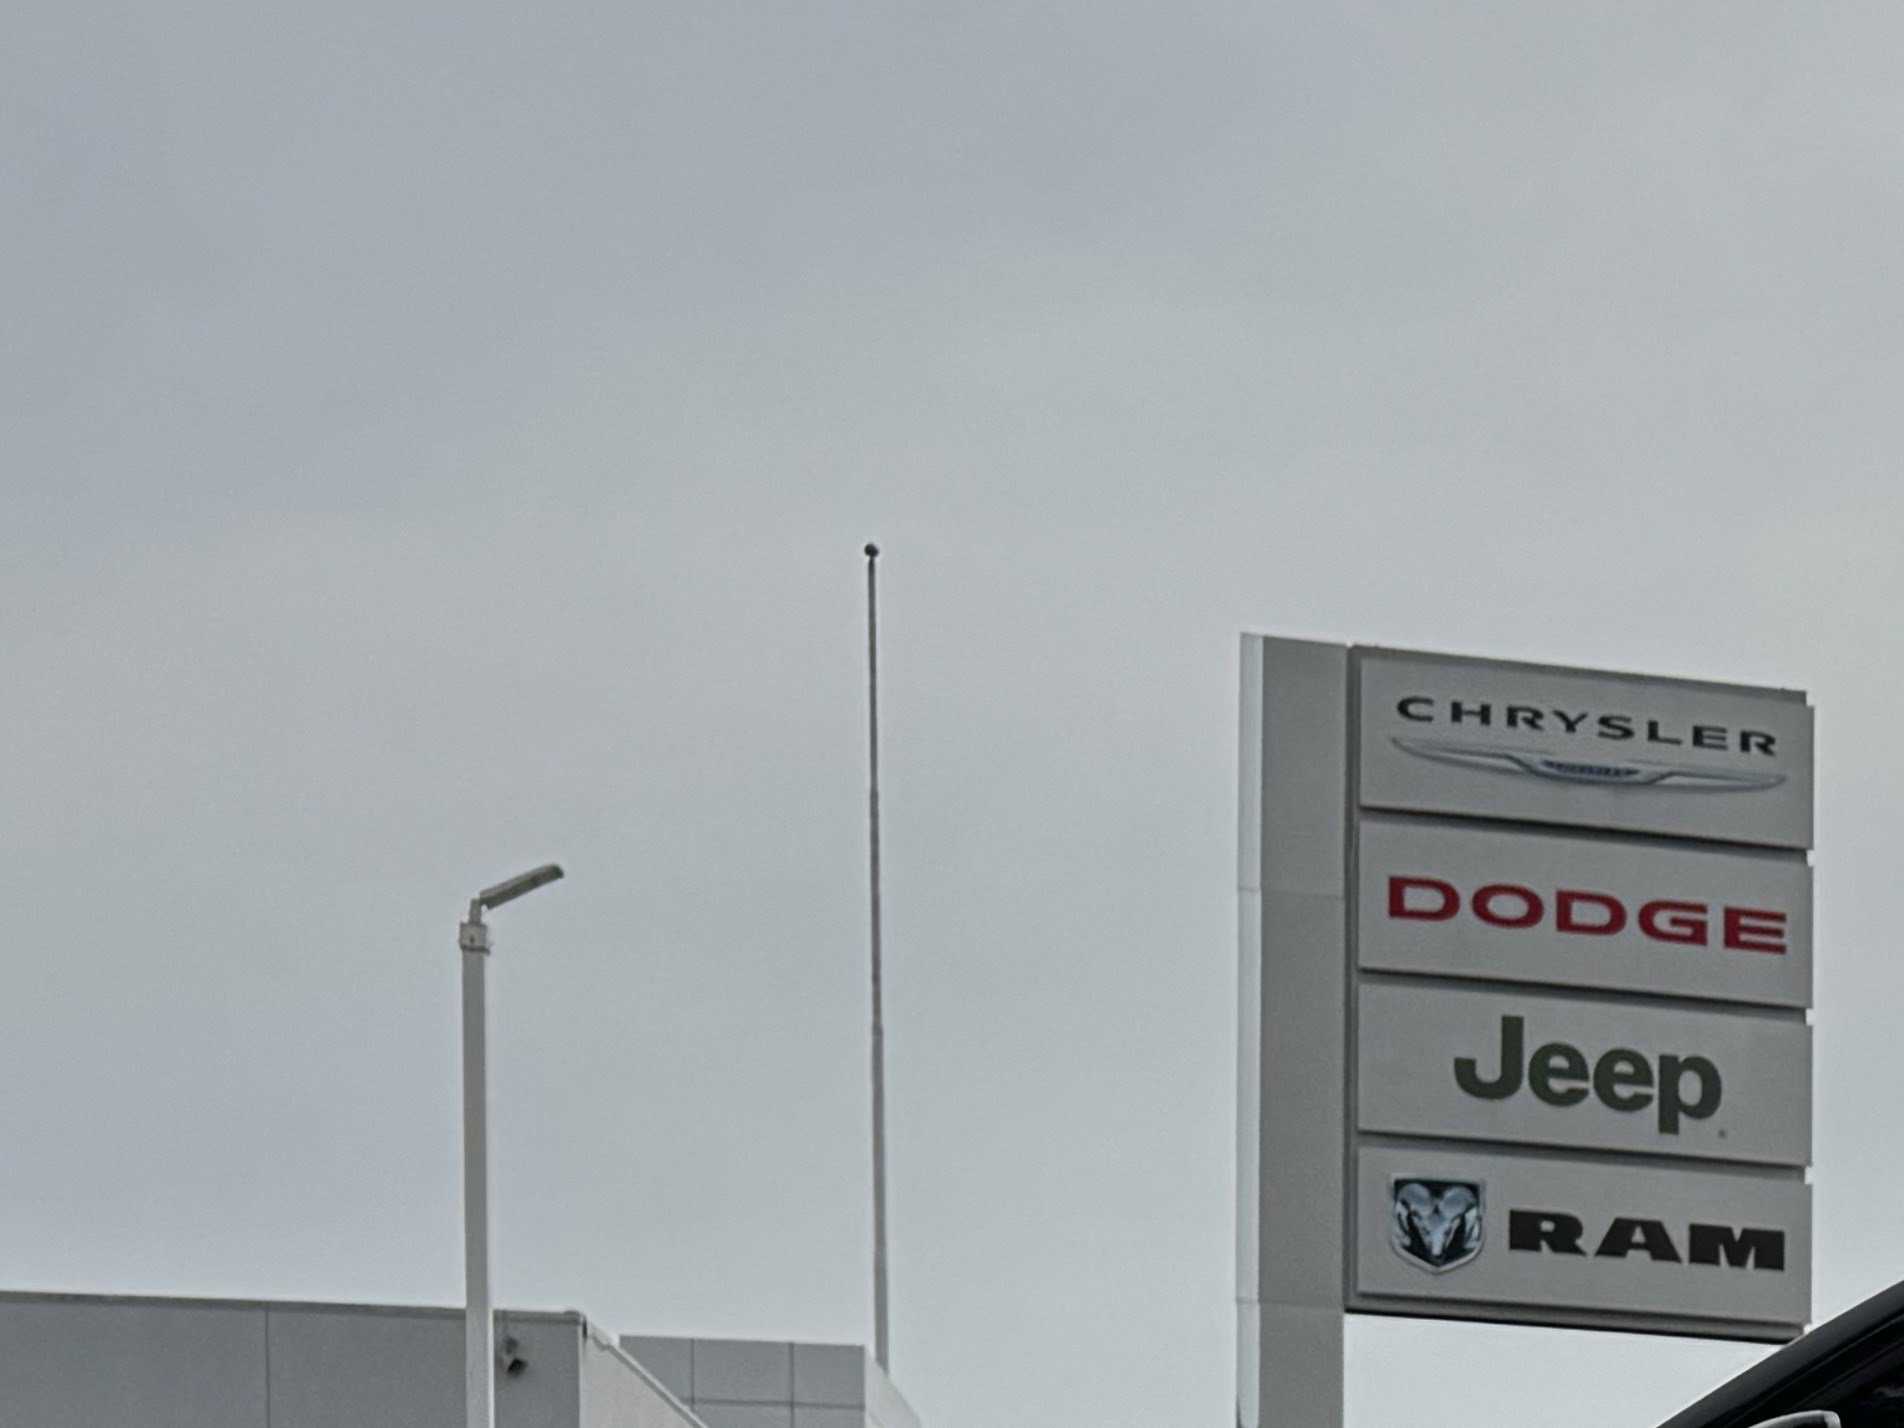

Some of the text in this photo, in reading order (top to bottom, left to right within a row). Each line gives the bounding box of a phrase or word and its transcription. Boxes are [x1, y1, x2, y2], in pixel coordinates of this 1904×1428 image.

[1397, 697, 1777, 756] CHRYSLER
[1387, 875, 1788, 955] DODGE
[1453, 1014, 1722, 1135] Jeep
[1508, 1208, 1786, 1272] RAM
